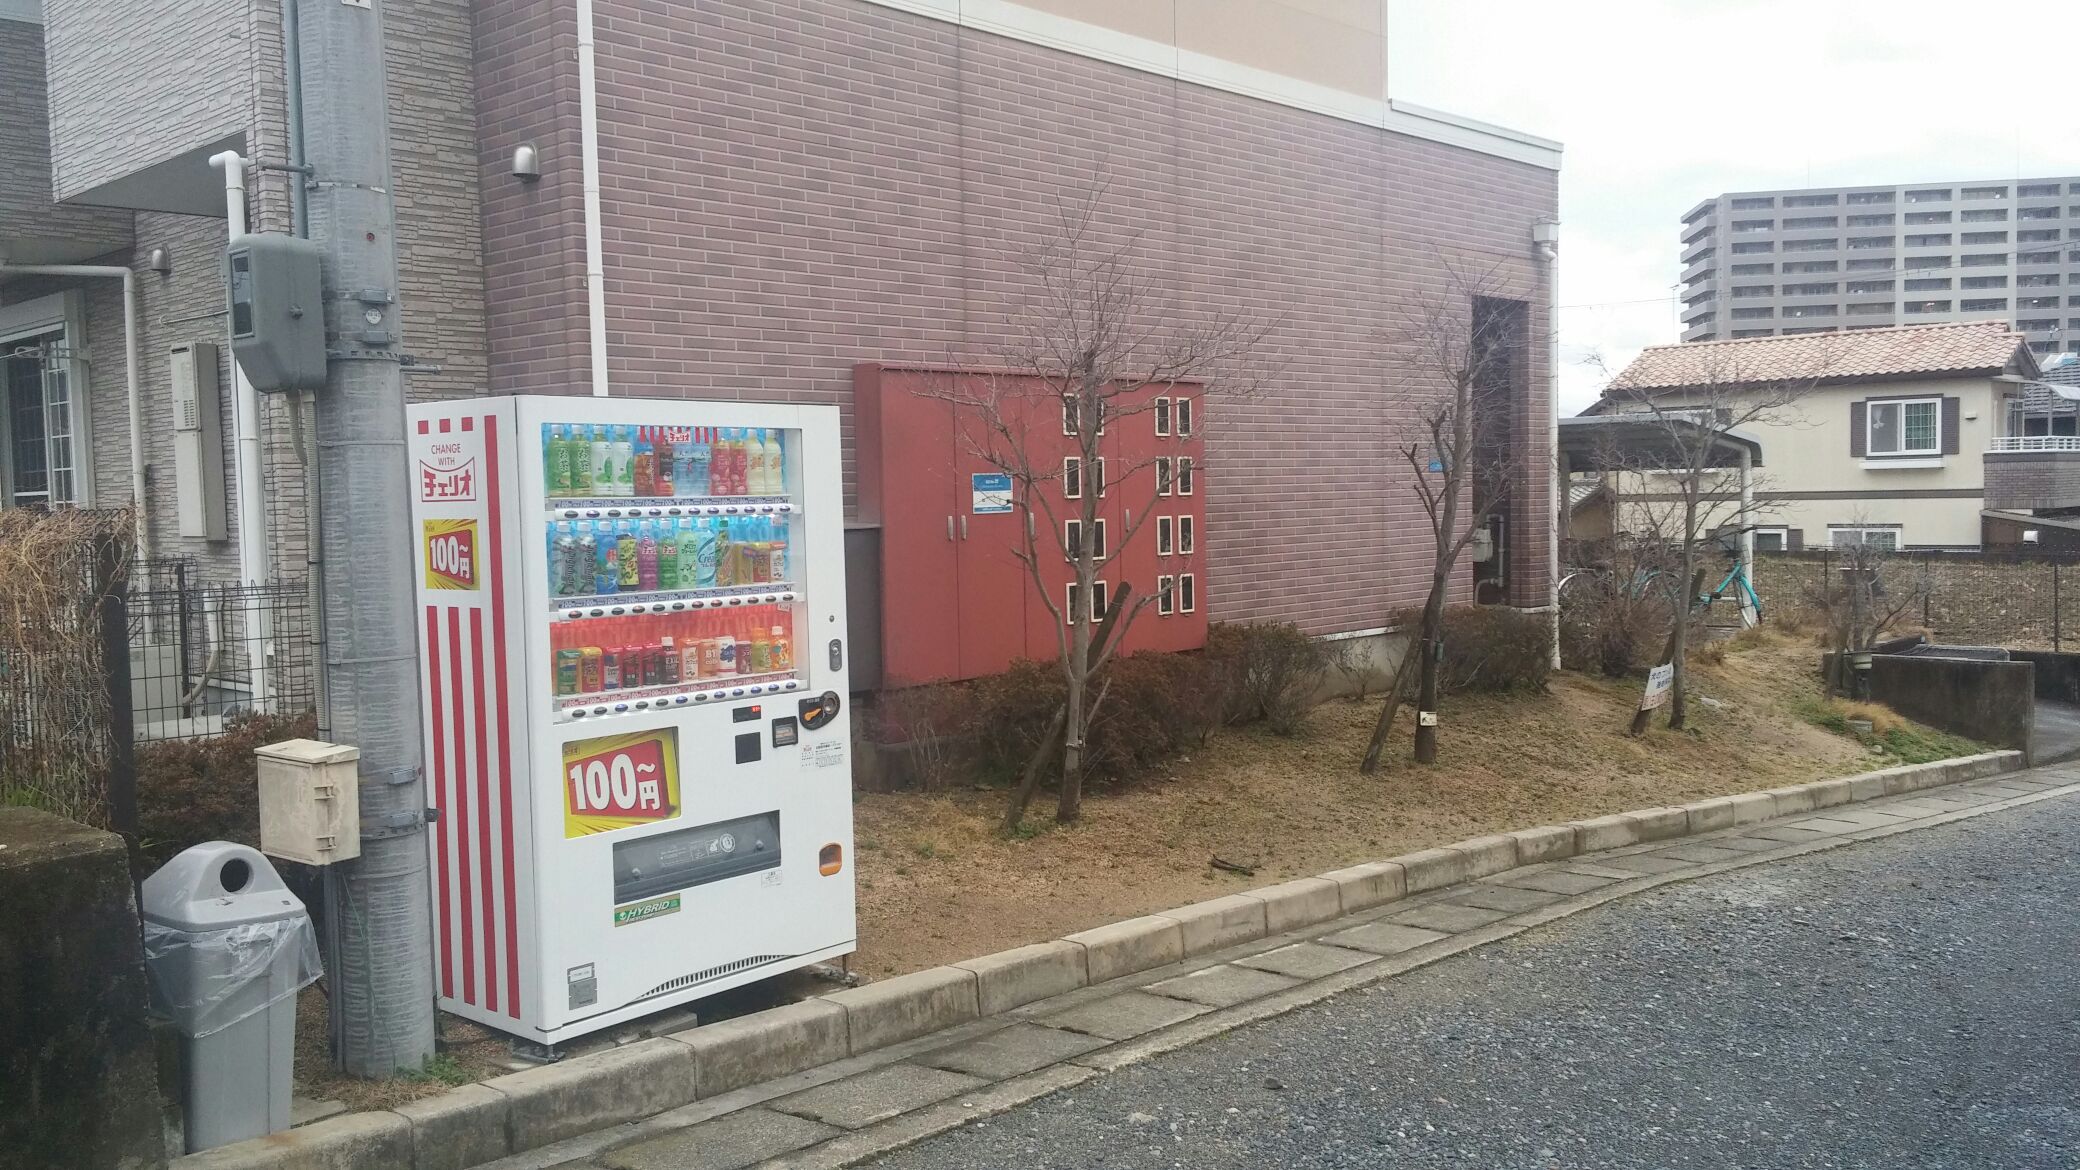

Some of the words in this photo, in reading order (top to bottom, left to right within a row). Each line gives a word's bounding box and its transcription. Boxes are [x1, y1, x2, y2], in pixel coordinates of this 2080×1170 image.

[431, 443, 461, 455] CHANGE
[437, 457, 456, 466] WITH
[424, 469, 471, 497] チェリオ
[626, 900, 670, 922] HYBRID
